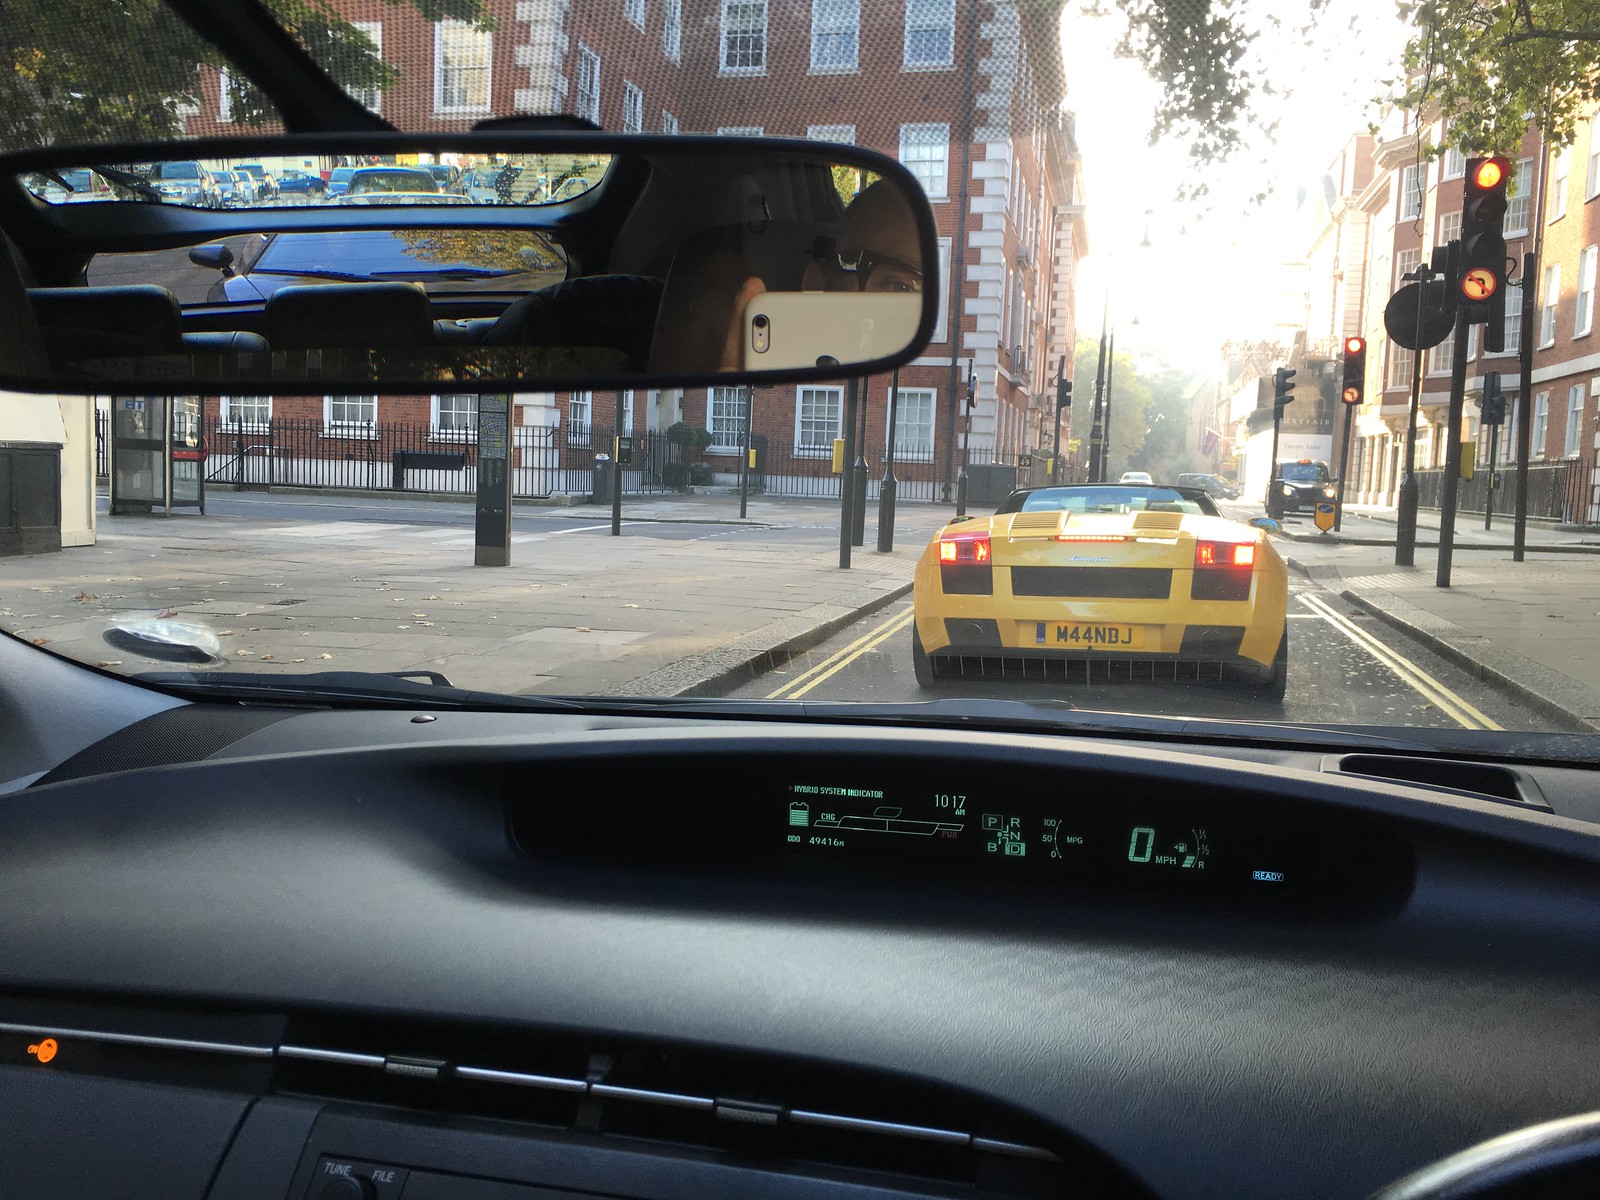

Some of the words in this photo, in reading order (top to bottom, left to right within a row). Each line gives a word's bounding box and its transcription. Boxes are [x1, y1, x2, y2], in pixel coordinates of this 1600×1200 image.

[124, 400, 145, 410] BT
[1056, 626, 1132, 644] M44NBJ
[794, 785, 819, 793] HYBRID
[820, 787, 846, 796] SYSTEM
[848, 789, 883, 799] INDICATOR
[955, 808, 966, 816] AM
[988, 817, 997, 827] P
[1011, 818, 1020, 827] R
[1043, 818, 1057, 827] 100
[1011, 832, 1020, 840] N
[1042, 834, 1053, 842] 50
[1067, 836, 1083, 844] MPG
[987, 842, 998, 852] B
[1011, 845, 1020, 853] D
[1128, 827, 1155, 862] 0
[1050, 850, 1057, 858] 0
[1155, 855, 1177, 865] MPH
[1198, 861, 1205, 869] R
[1254, 872, 1282, 881] READY
[324, 1162, 352, 1176] TUNE
[371, 1170, 395, 1183] FILE
